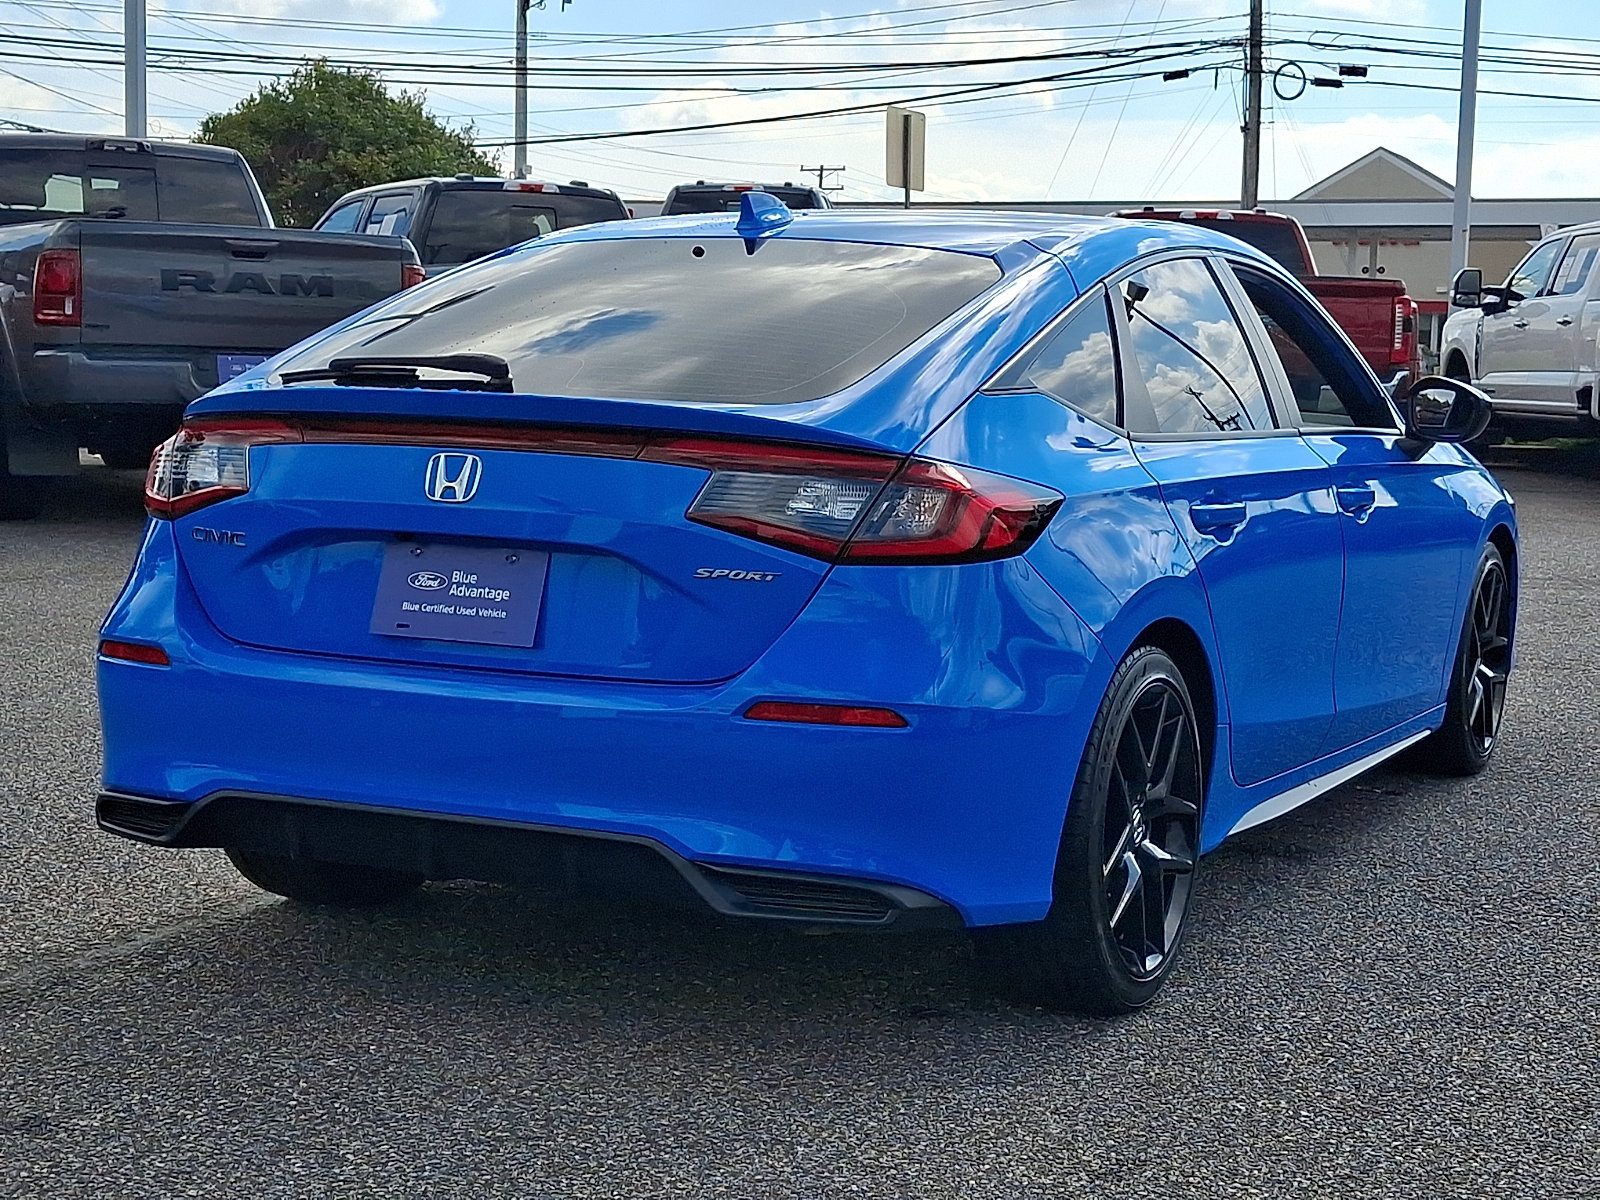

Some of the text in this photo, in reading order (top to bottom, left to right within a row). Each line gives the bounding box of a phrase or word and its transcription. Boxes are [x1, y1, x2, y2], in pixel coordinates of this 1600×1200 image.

[161, 269, 335, 297] RAM
[192, 526, 246, 547] CIVIC
[414, 573, 442, 588] Ford
[452, 570, 478, 584] Blue
[693, 568, 782, 581] SPORT
[449, 584, 510, 602] Advantage
[402, 601, 507, 619] Blue Certified Used Vehicle
